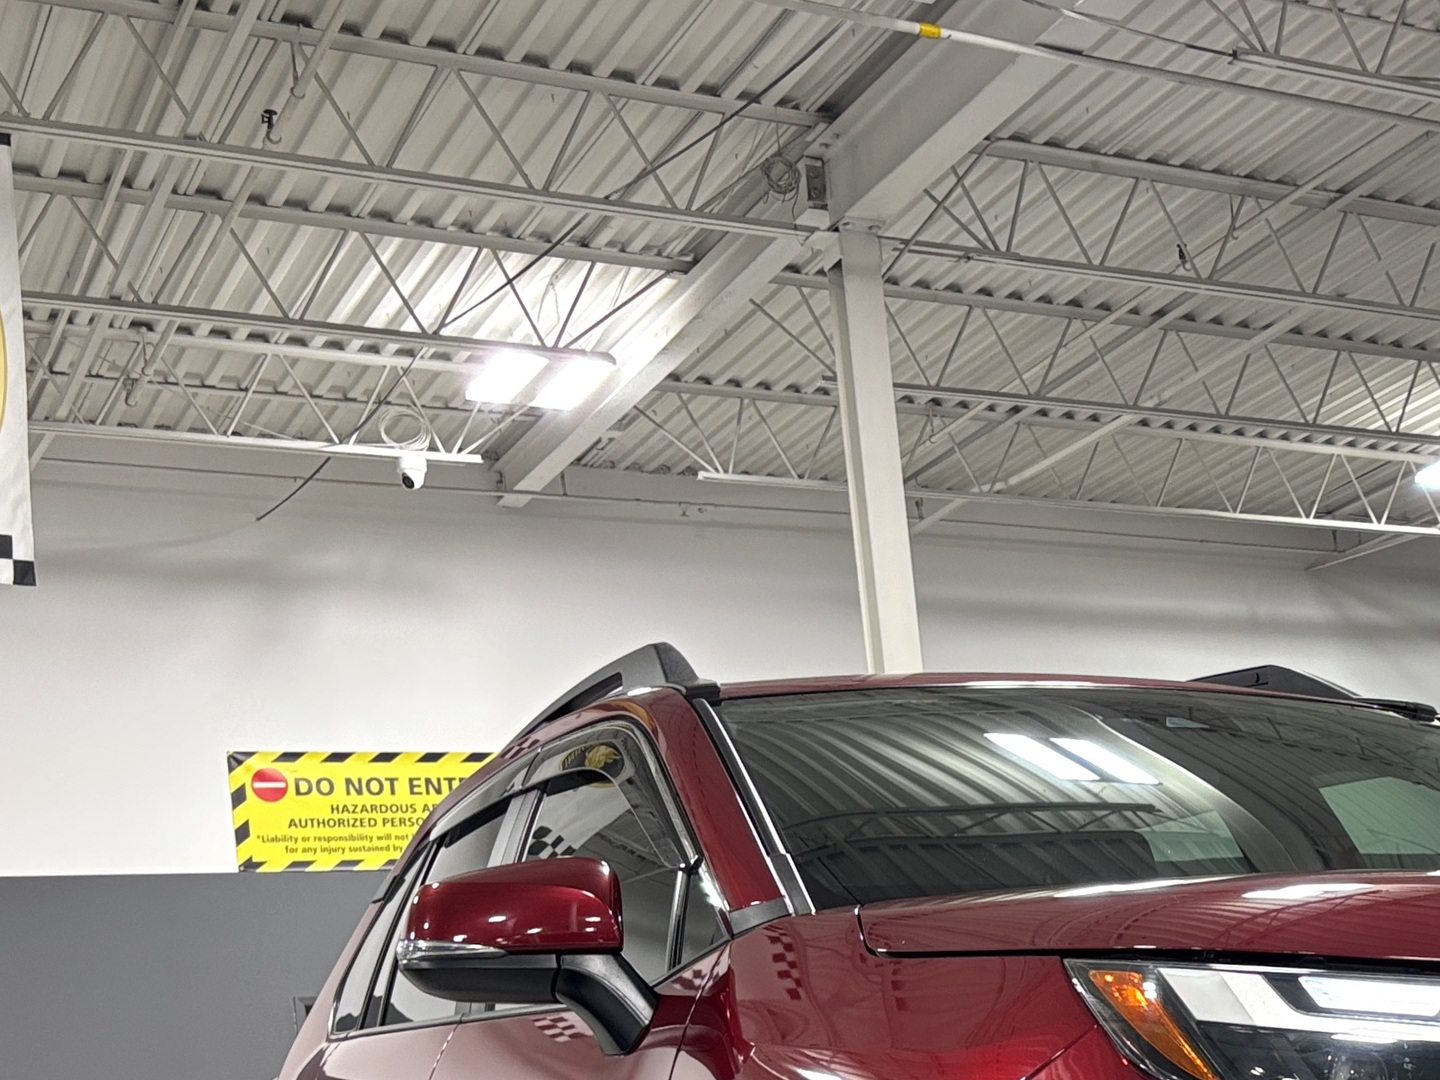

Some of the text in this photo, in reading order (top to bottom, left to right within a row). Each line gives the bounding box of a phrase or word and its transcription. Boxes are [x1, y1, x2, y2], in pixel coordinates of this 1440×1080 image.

[294, 776, 468, 796] DO NOT ENT
[330, 803, 417, 814] HAZARDOUS
[288, 818, 377, 829] AUTHORIZED
[313, 834, 373, 844] responsibility
[376, 833, 392, 841] will
[285, 844, 404, 855] for any injury sustained by
